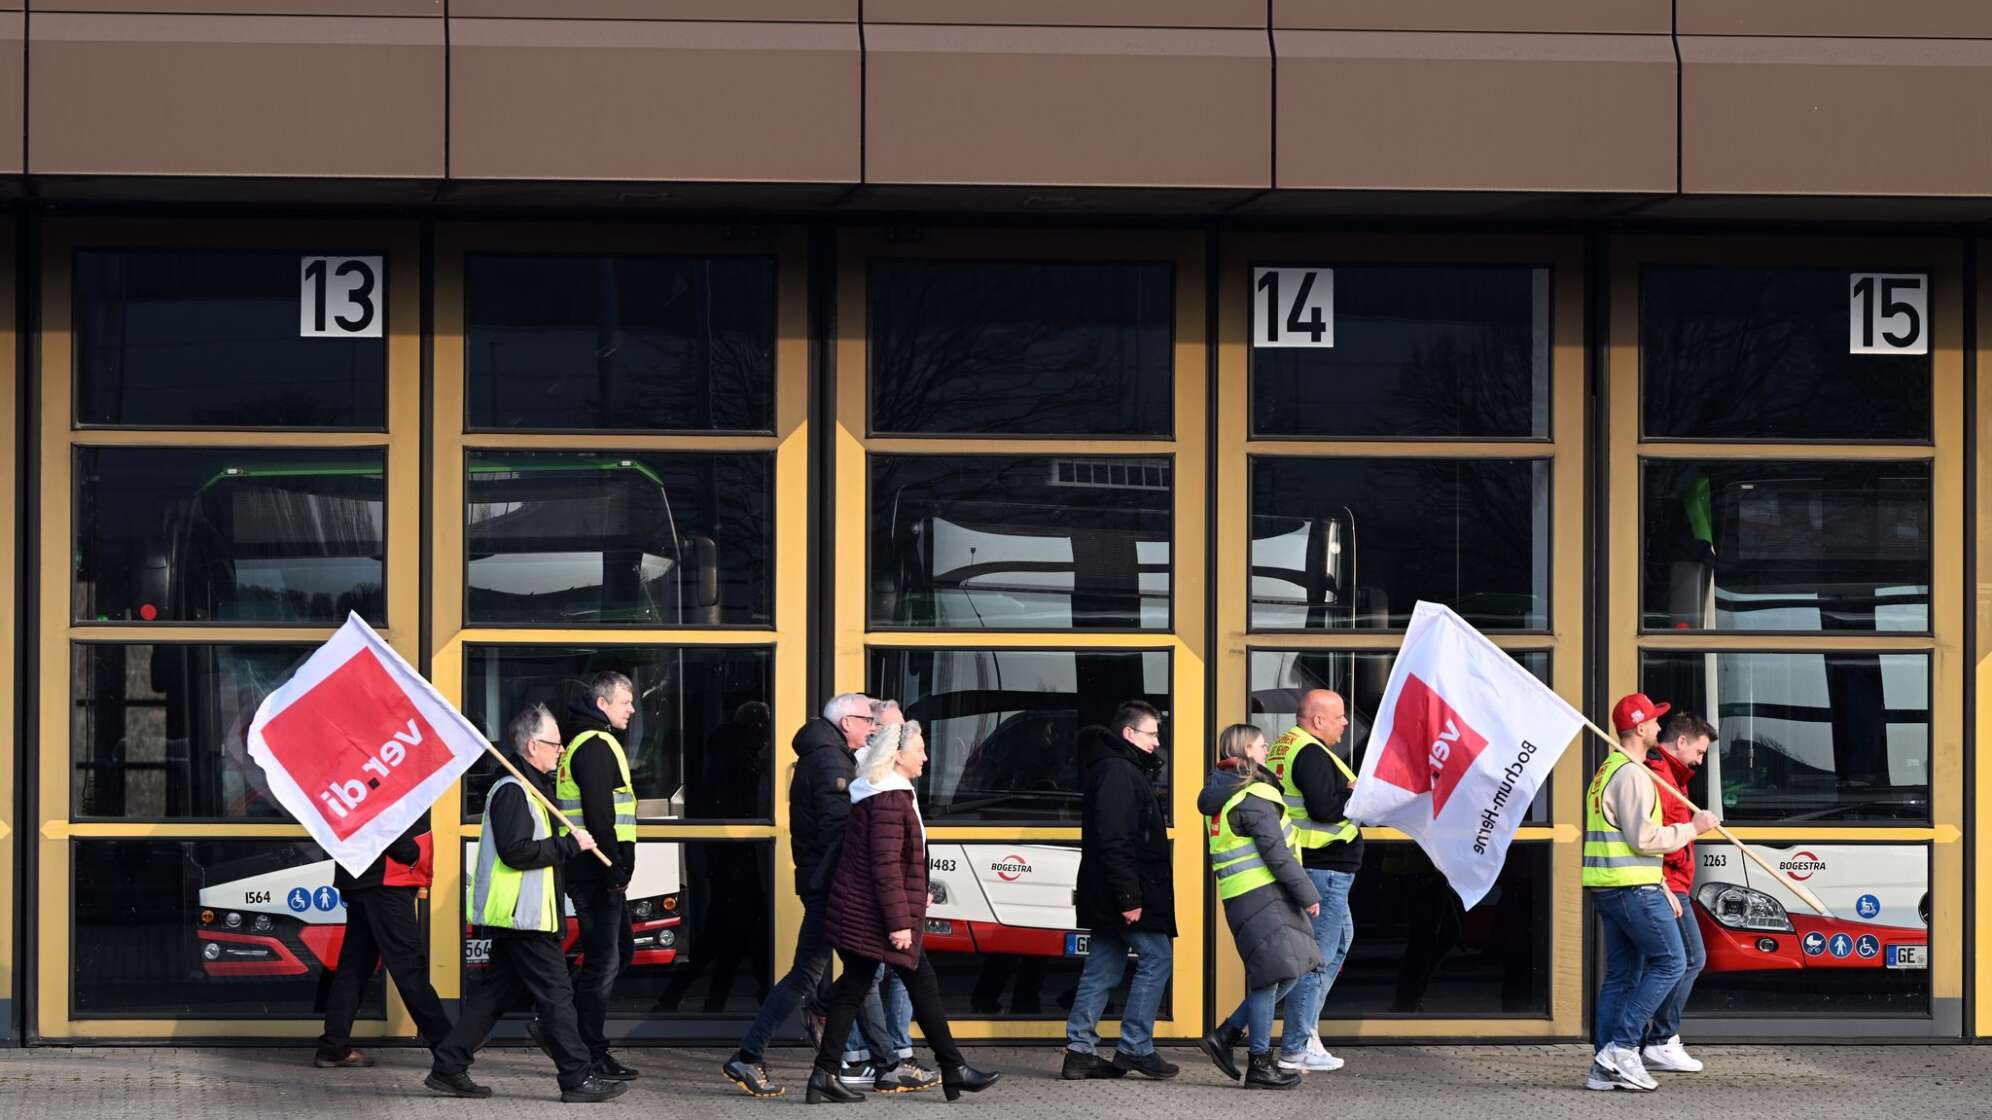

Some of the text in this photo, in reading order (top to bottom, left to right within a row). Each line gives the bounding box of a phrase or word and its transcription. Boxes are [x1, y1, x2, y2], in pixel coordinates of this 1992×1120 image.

[304, 260, 376, 332] 13
[1257, 271, 1327, 343] 14
[1852, 277, 1921, 349] 15
[930, 858, 957, 871] 1483
[991, 863, 1032, 873] BOGESTRA
[1703, 855, 1727, 867] 2263
[1779, 861, 1827, 870] BOGESTRA
[245, 890, 271, 904] 1564
[1077, 936, 1089, 953] G
[1898, 948, 1916, 964] GE
